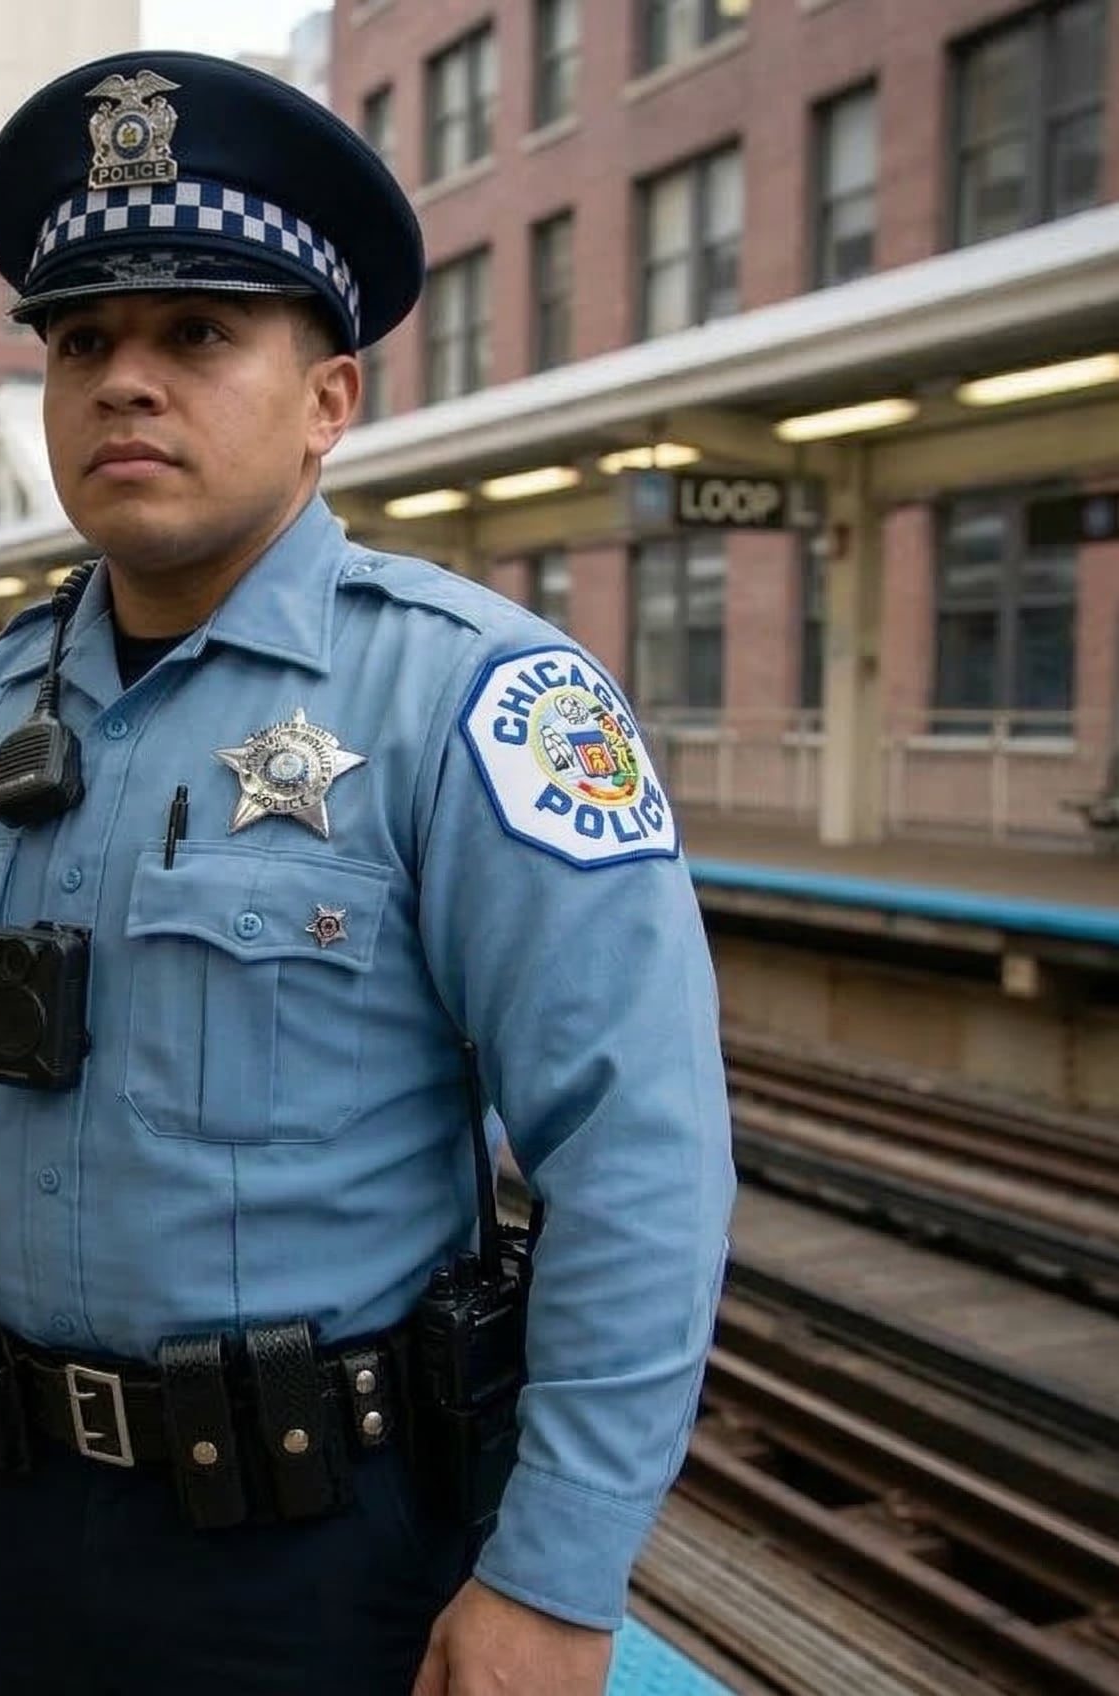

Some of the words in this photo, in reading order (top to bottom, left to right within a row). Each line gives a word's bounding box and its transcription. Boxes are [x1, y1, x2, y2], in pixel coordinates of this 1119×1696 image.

[98, 162, 167, 183] POLICE
[681, 479, 780, 523] LOOP
[493, 661, 635, 746] CHICAGO
[534, 776, 665, 843] POLICE
